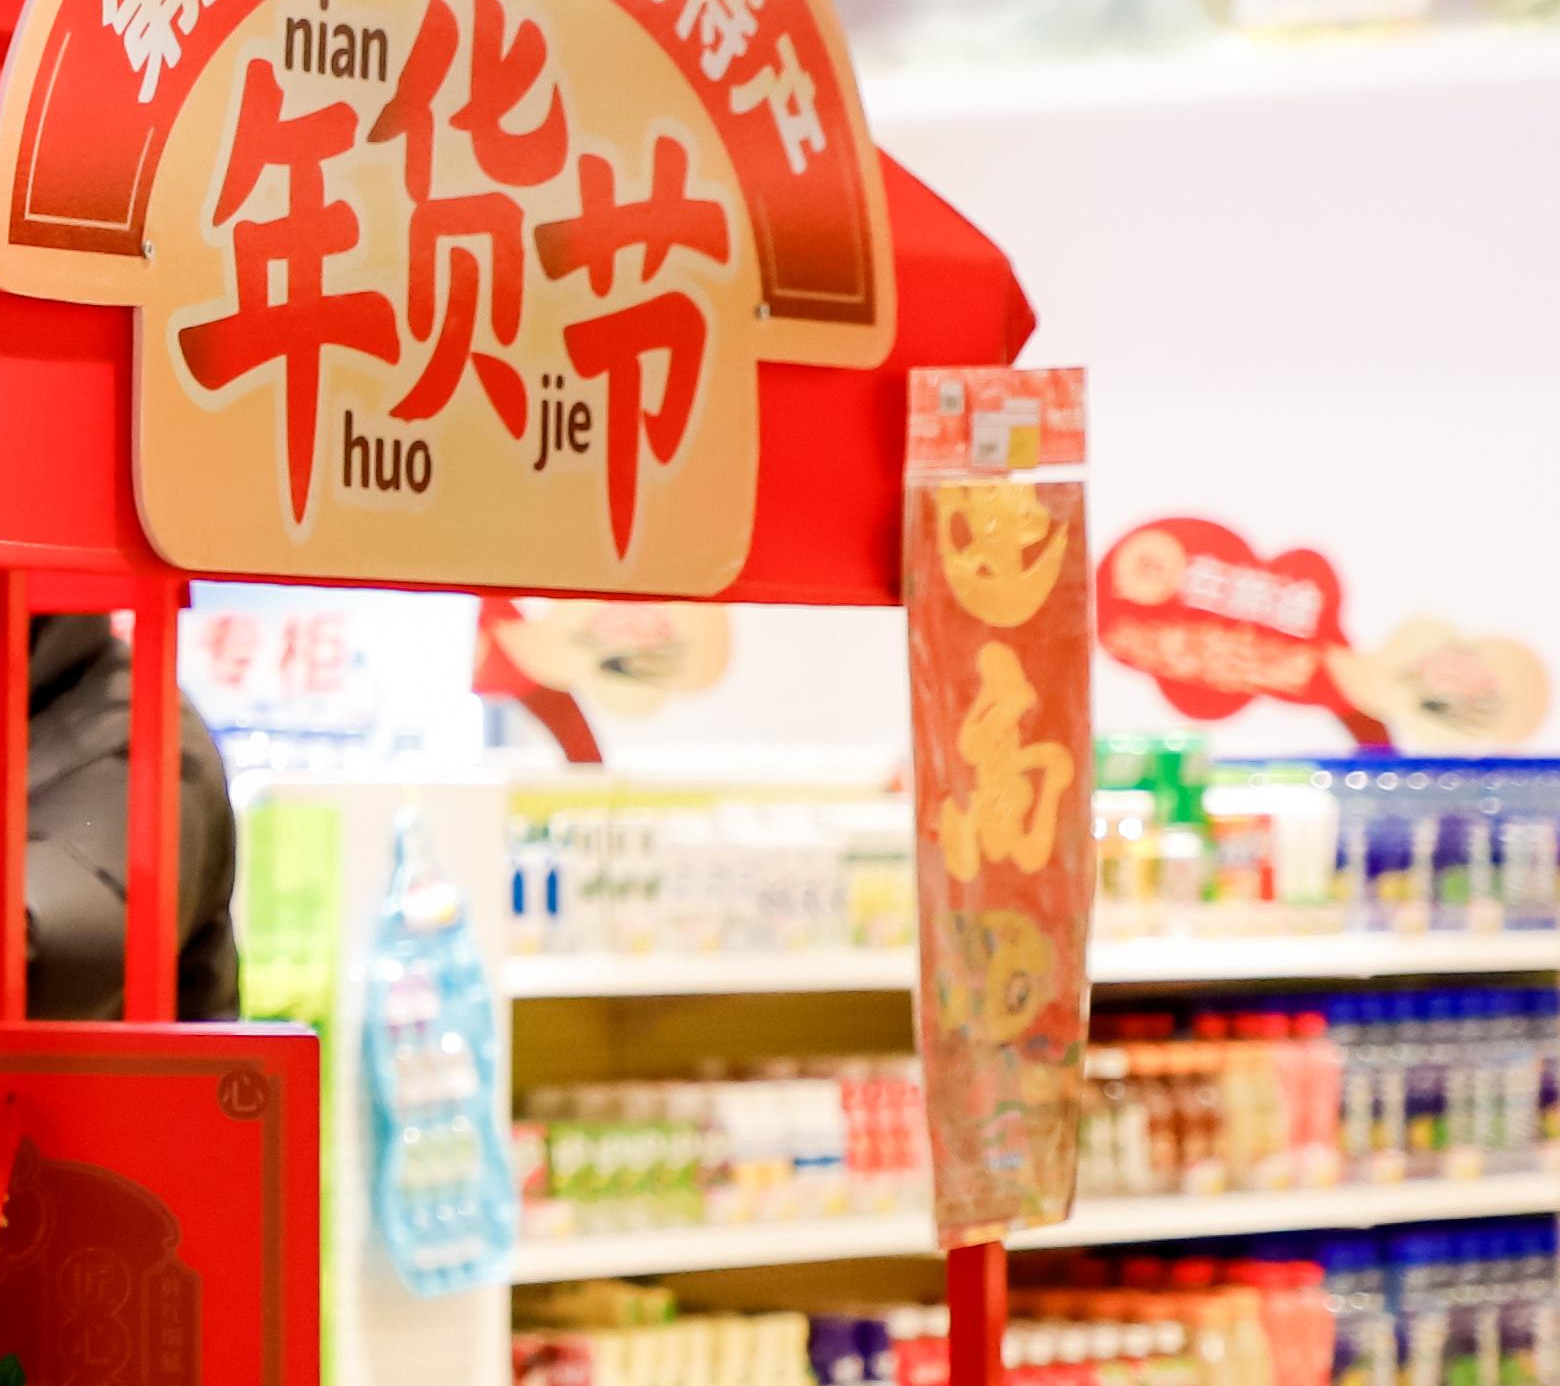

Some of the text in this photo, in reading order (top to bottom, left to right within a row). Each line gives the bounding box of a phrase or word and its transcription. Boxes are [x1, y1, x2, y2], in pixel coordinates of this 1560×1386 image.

[283, 7, 389, 82] nian
[343, 413, 433, 495] huo
[533, 377, 593, 473] jie
